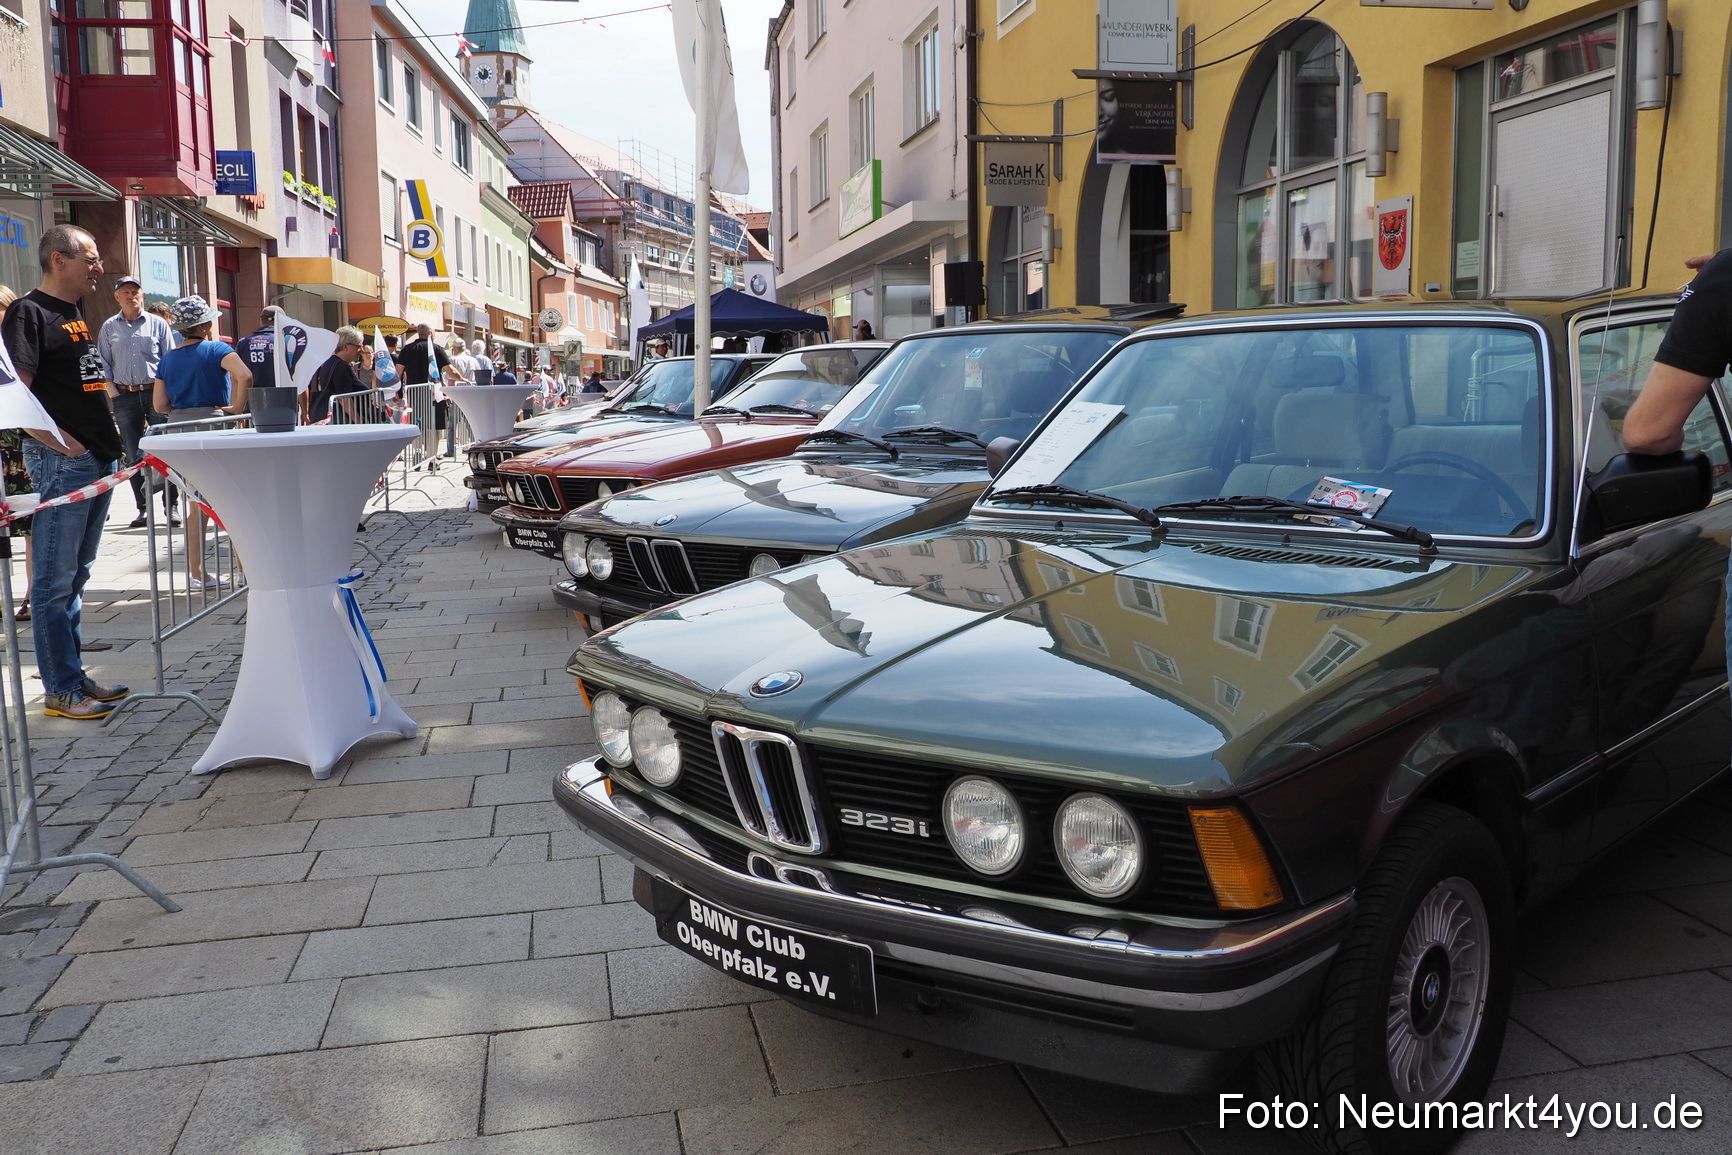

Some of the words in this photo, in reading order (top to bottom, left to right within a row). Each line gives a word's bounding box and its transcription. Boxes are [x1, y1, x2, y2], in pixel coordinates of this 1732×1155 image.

[1035, 163, 1045, 178] K
[412, 229, 430, 248] B
[152, 259, 175, 284] CECIL
[249, 343, 266, 351] CAMP
[250, 351, 265, 363] 63
[517, 528, 532, 538] BMW
[532, 529, 548, 538] Club
[514, 537, 543, 548] Oberpfalz
[543, 540, 556, 549] e.V.
[840, 808, 929, 838] 323i
[689, 899, 738, 941] BMW
[746, 925, 806, 961] Club
[676, 921, 779, 984] Oberpfalz
[785, 971, 836, 1000] e.V.
